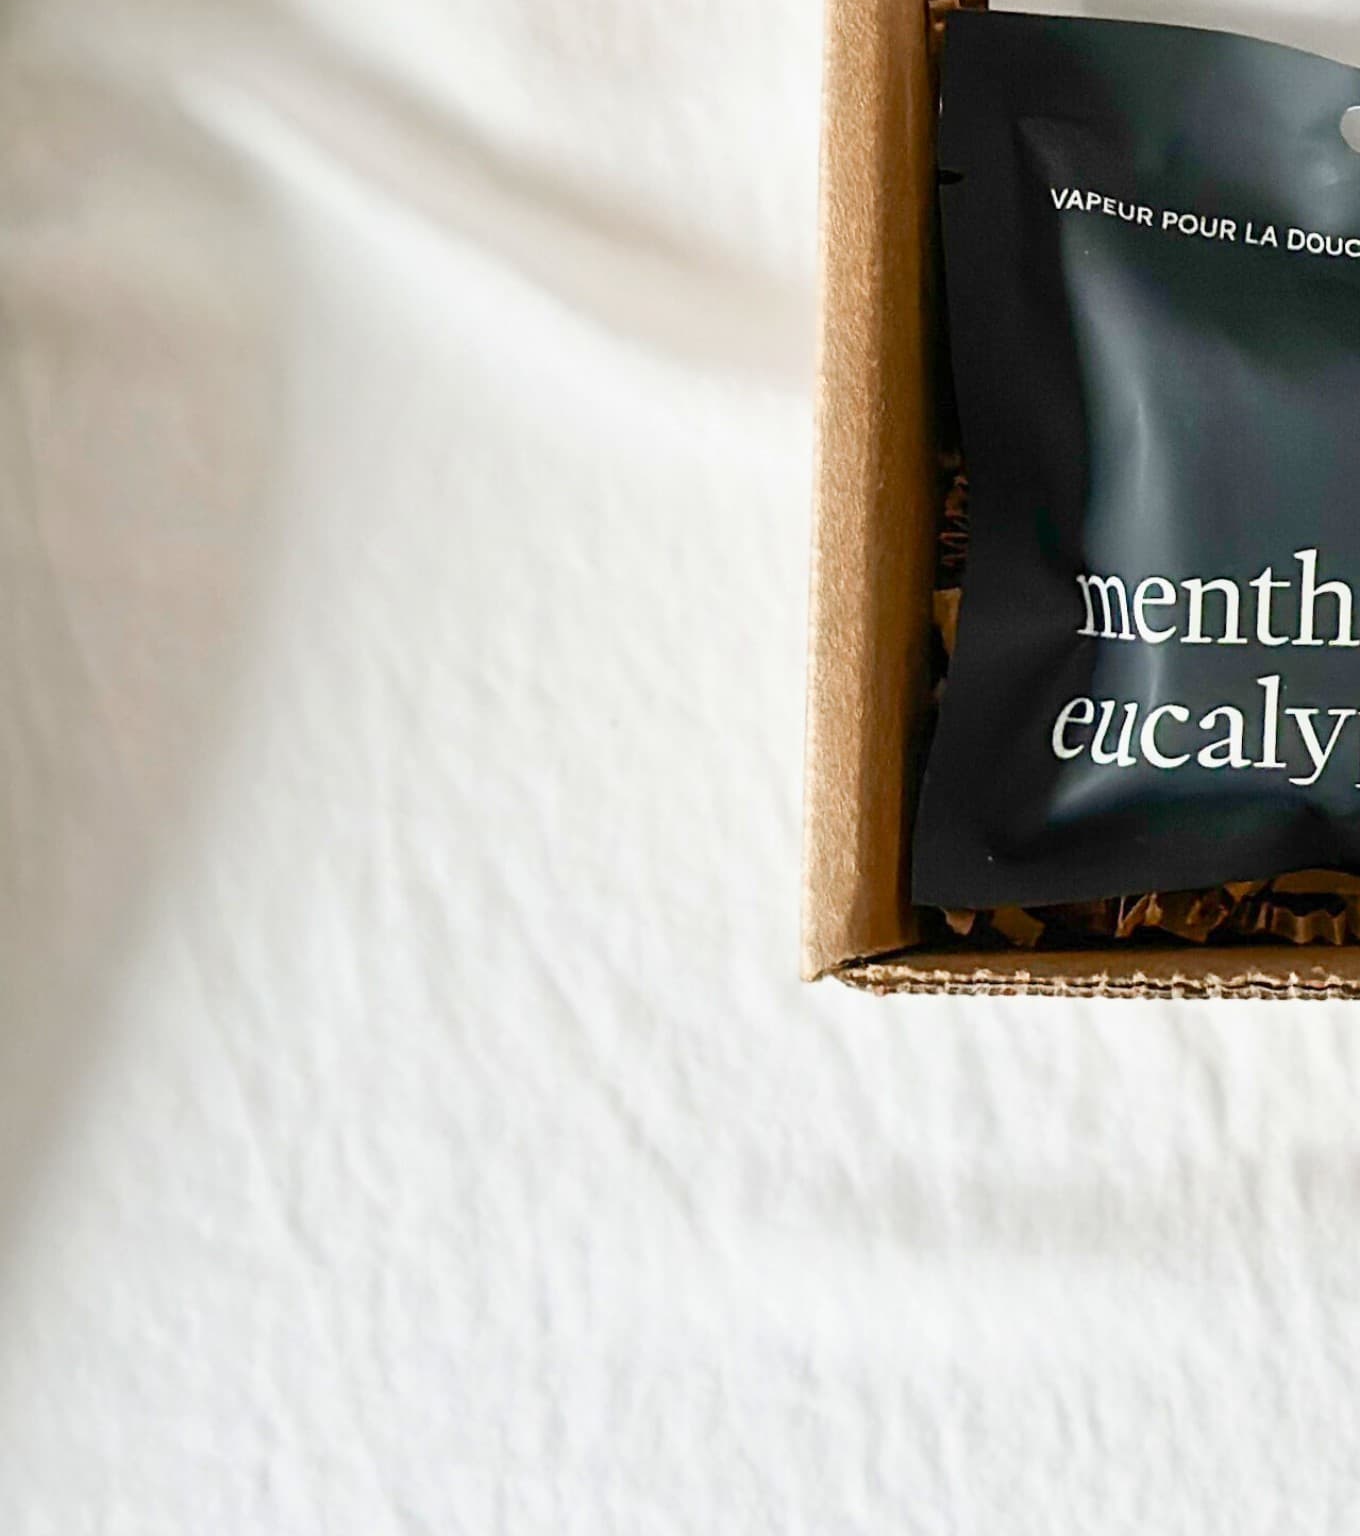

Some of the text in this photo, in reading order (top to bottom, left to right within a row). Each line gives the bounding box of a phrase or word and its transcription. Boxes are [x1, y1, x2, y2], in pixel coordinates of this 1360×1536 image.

[1050, 188, 1152, 225] VAPEUR
[1161, 211, 1235, 241] POUR
[1245, 222, 1278, 247] LA
